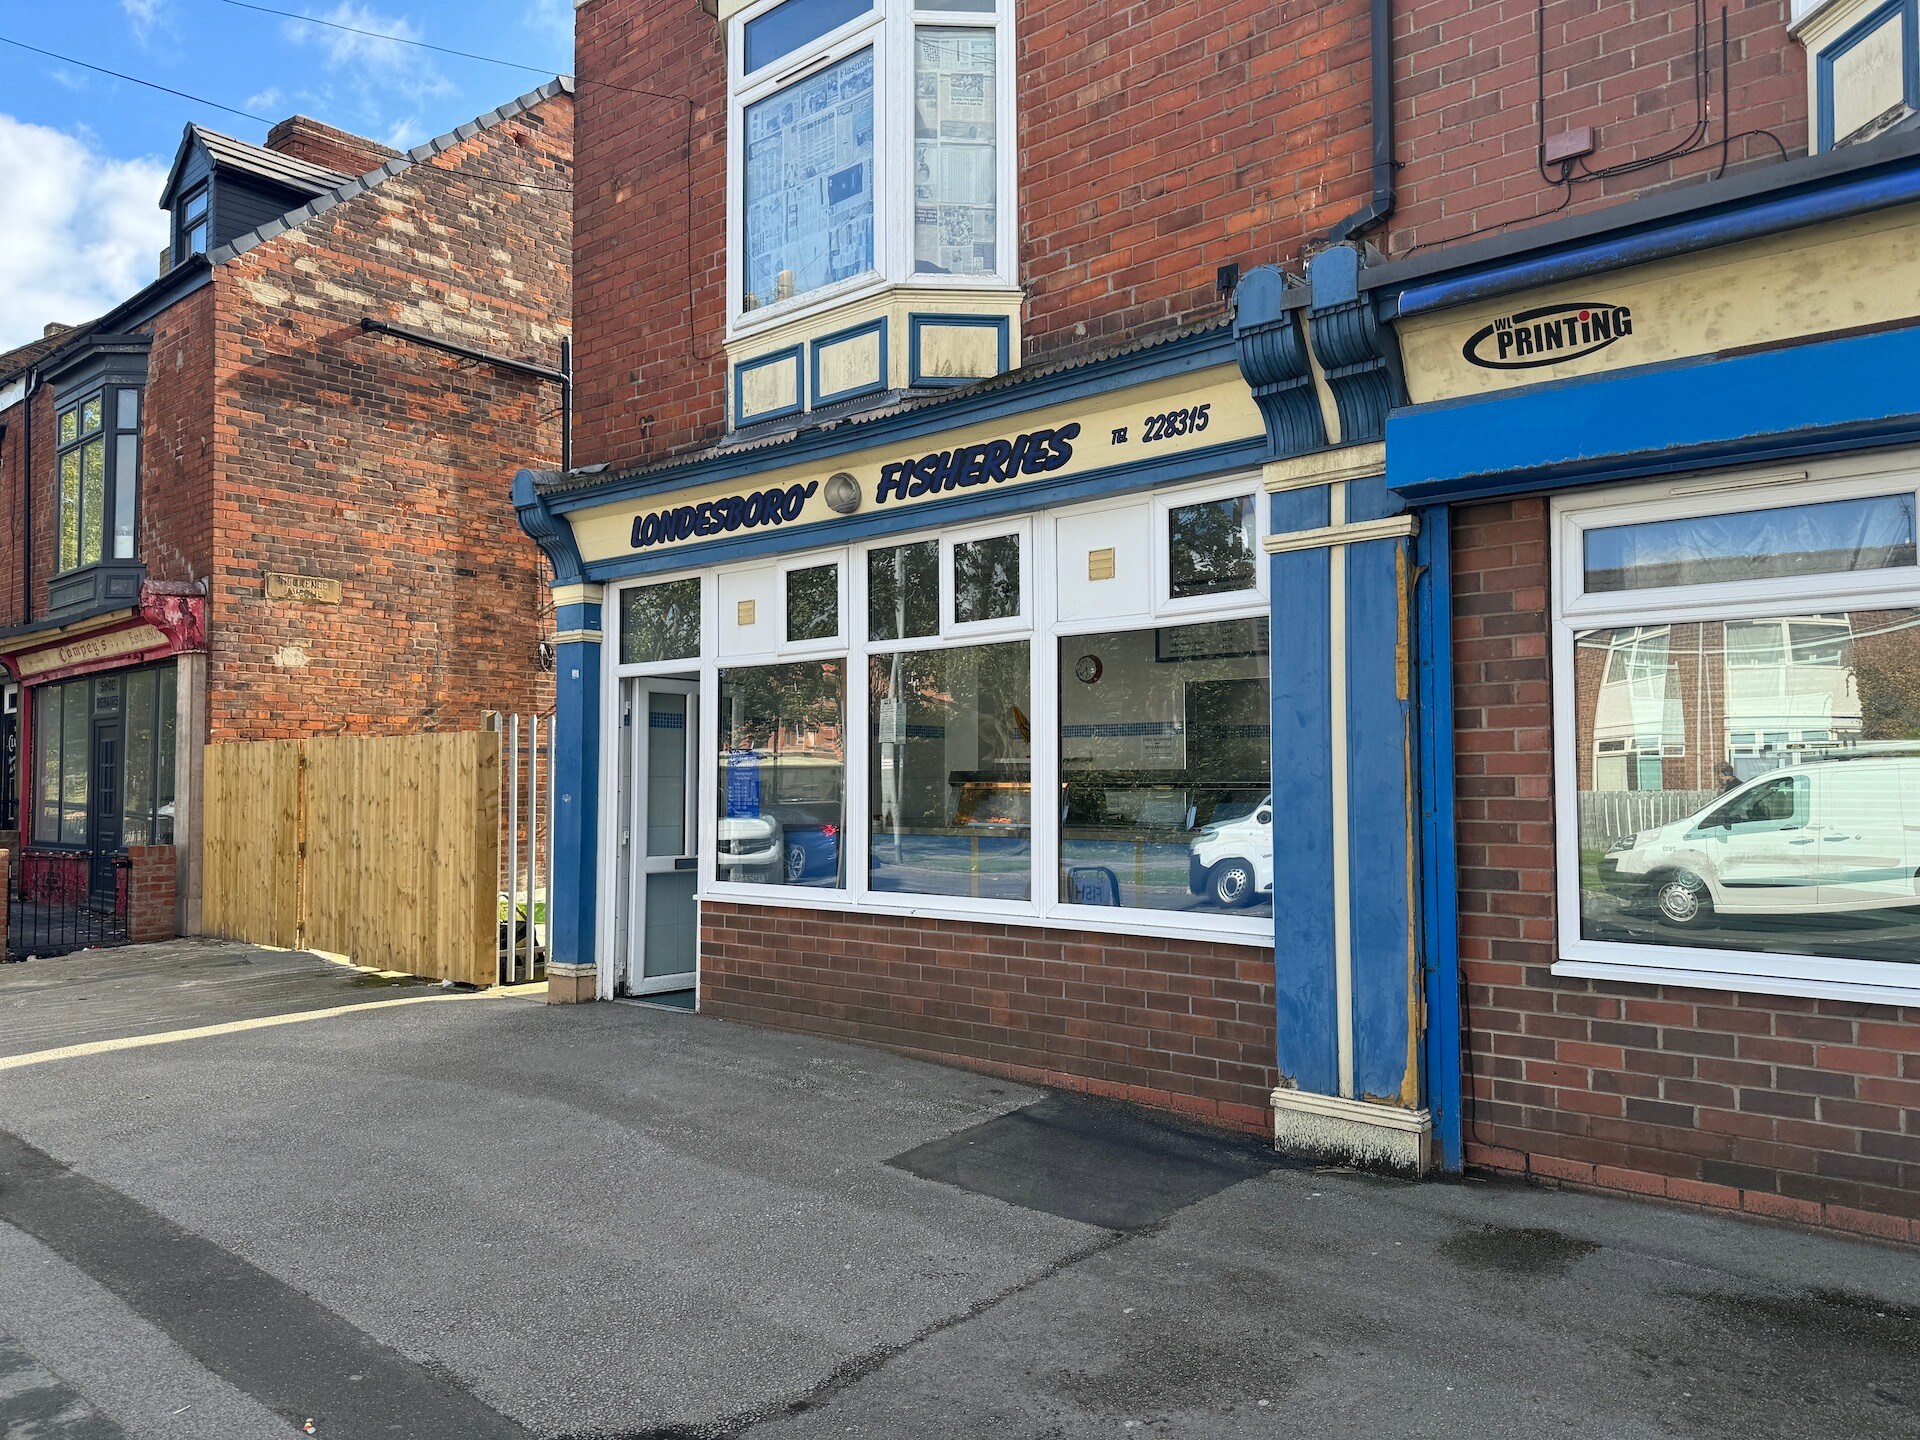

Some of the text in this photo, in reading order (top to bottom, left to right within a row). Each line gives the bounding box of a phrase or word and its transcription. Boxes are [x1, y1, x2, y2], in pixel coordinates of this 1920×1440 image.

[1494, 316, 1513, 332] WL
[875, 422, 1081, 503] FISHERIES
[1141, 403, 1211, 443] 228315
[284, 587, 322, 600] AVE
[100, 679, 116, 692] SHOE
[96, 695, 119, 709] REPAIRS
